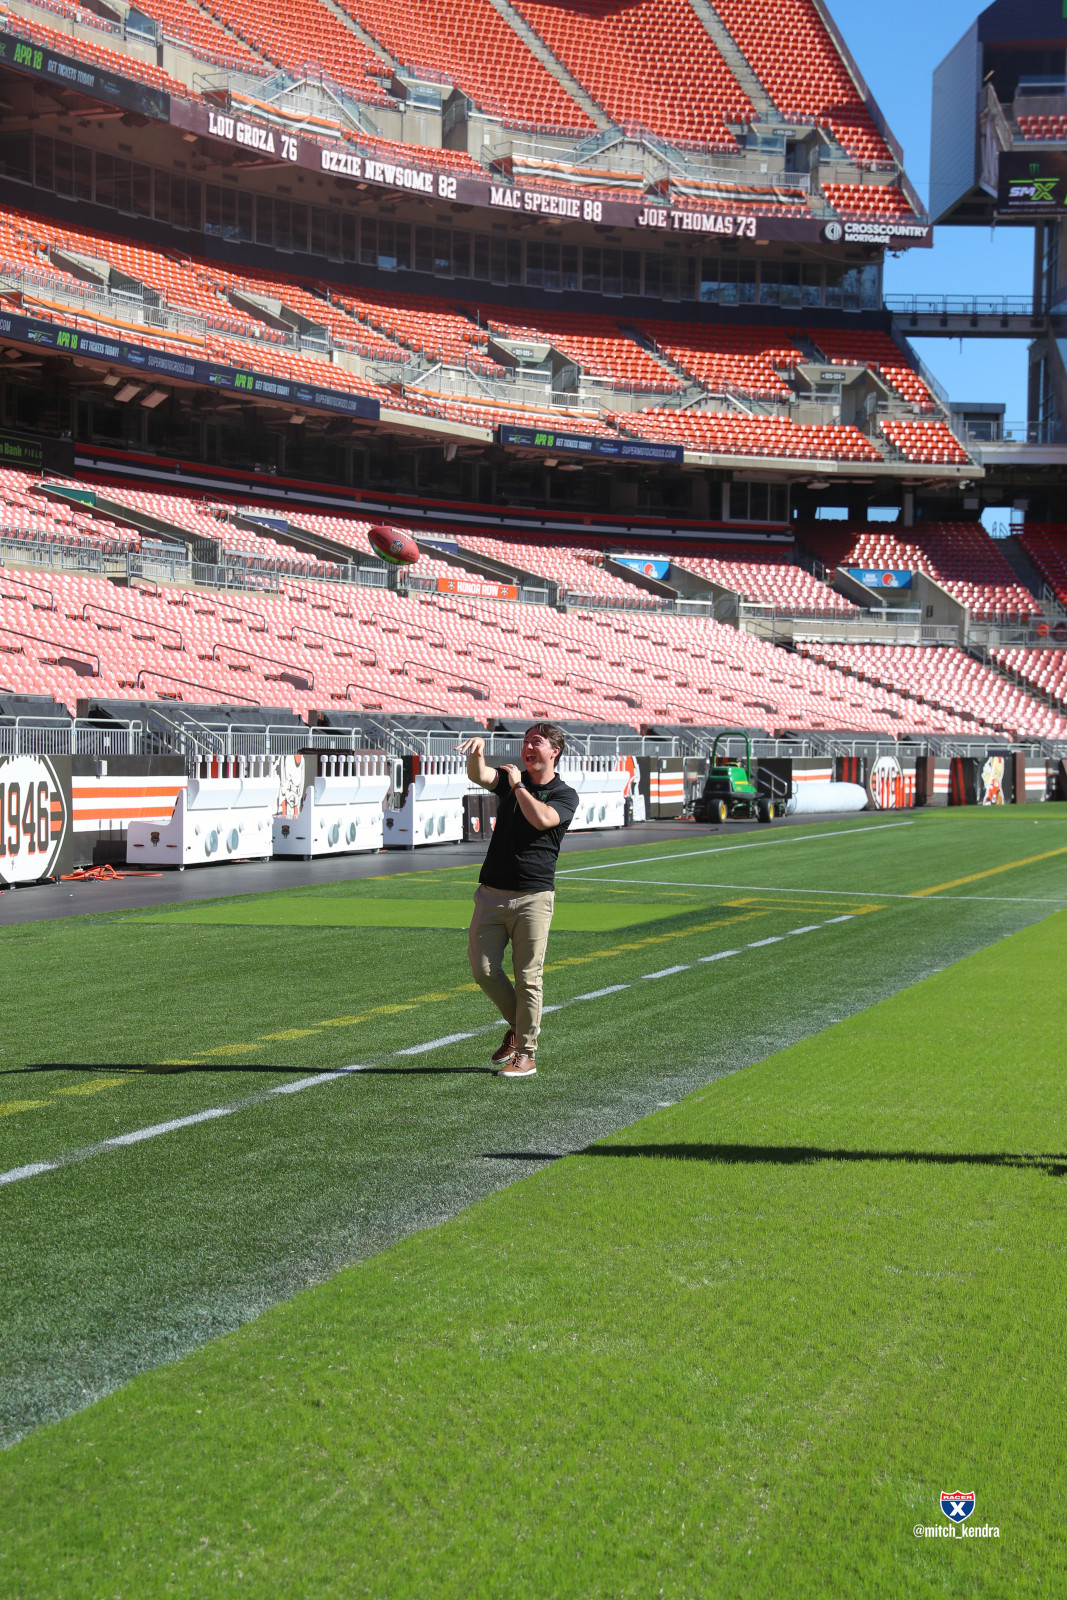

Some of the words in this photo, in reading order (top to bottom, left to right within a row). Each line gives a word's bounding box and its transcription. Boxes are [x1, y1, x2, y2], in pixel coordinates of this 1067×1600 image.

[14, 43, 32, 66] APR
[32, 50, 43, 70] 18
[47, 60, 58, 74] GET
[57, 63, 77, 80] TICKETS
[77, 70, 94, 87] TODAY!
[208, 113, 234, 140] LOU
[236, 122, 275, 154] GROZA
[280, 135, 298, 162] 76
[321, 149, 362, 177] OZZIE
[364, 160, 433, 193] NEWSOME
[438, 175, 457, 199] 82
[1008, 183, 1056, 200] SMX
[489, 186, 522, 209] MAC
[524, 192, 580, 219] SPEEDIE
[583, 200, 603, 222] 88
[638, 207, 667, 228] JOE
[671, 211, 733, 235] THOMAS
[736, 217, 757, 238] 73
[844, 223, 928, 237] CROSSCOUNTRY
[844, 233, 890, 244] MORTGAGE
[57, 330, 70, 348] APR
[70, 334, 78, 349] 18
[80, 338, 88, 350] GET
[88, 340, 104, 354] TICKETS
[104, 344, 119, 357] TODAY!
[148, 354, 194, 375] SUPERMOTOCROSS.COM
[234, 374, 246, 388] APR
[246, 376, 254, 390] 18
[255, 380, 263, 390] GET
[534, 433, 547, 446] APR
[547, 434, 554, 446] 18
[4, 443, 22, 456] Bank
[24, 448, 42, 459] FIELD
[622, 446, 676, 458] SUPERMOTOCROSS.COM
[457, 581, 481, 595] HONOR
[482, 583, 499, 597] ROW
[0, 780, 52, 858] 1946
